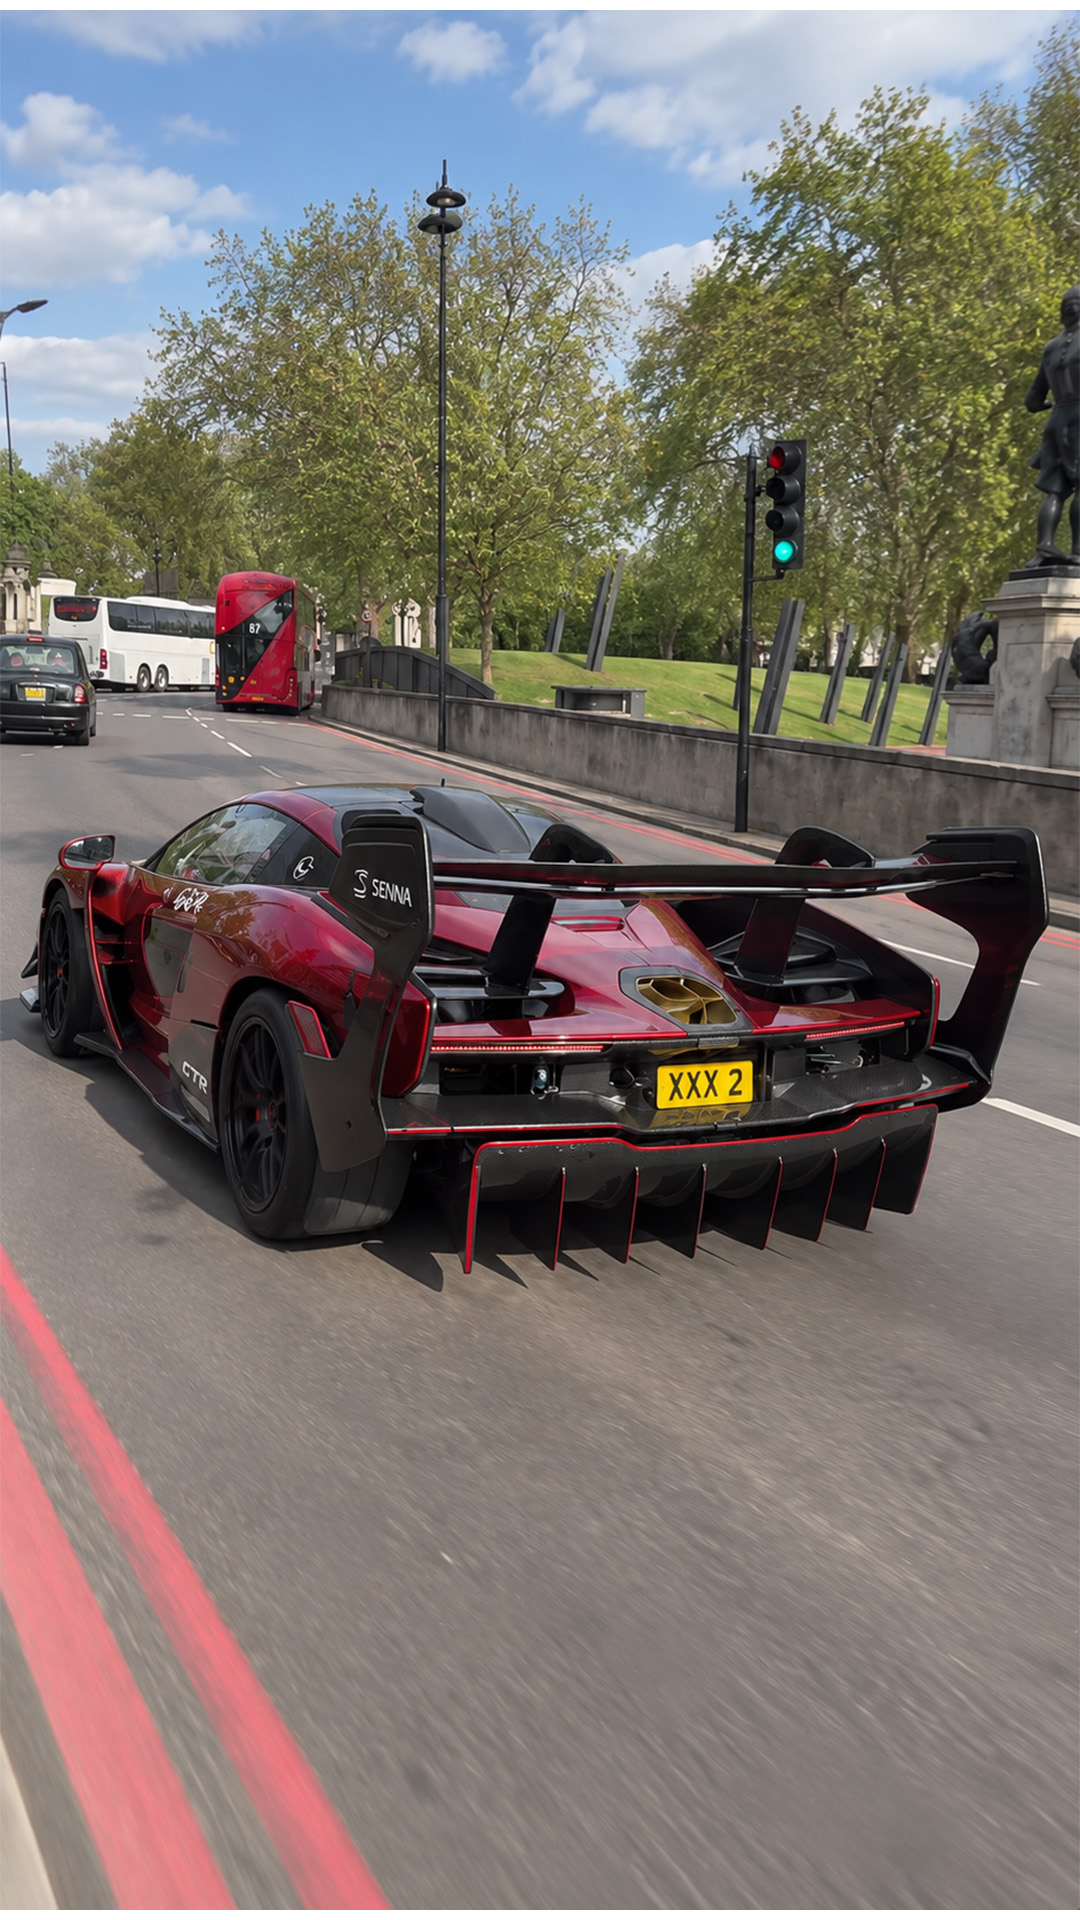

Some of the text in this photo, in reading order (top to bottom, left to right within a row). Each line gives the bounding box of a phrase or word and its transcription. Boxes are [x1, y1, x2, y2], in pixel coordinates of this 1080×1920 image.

[372, 878, 413, 908] SENNA
[668, 1068, 743, 1101] XXX 2
